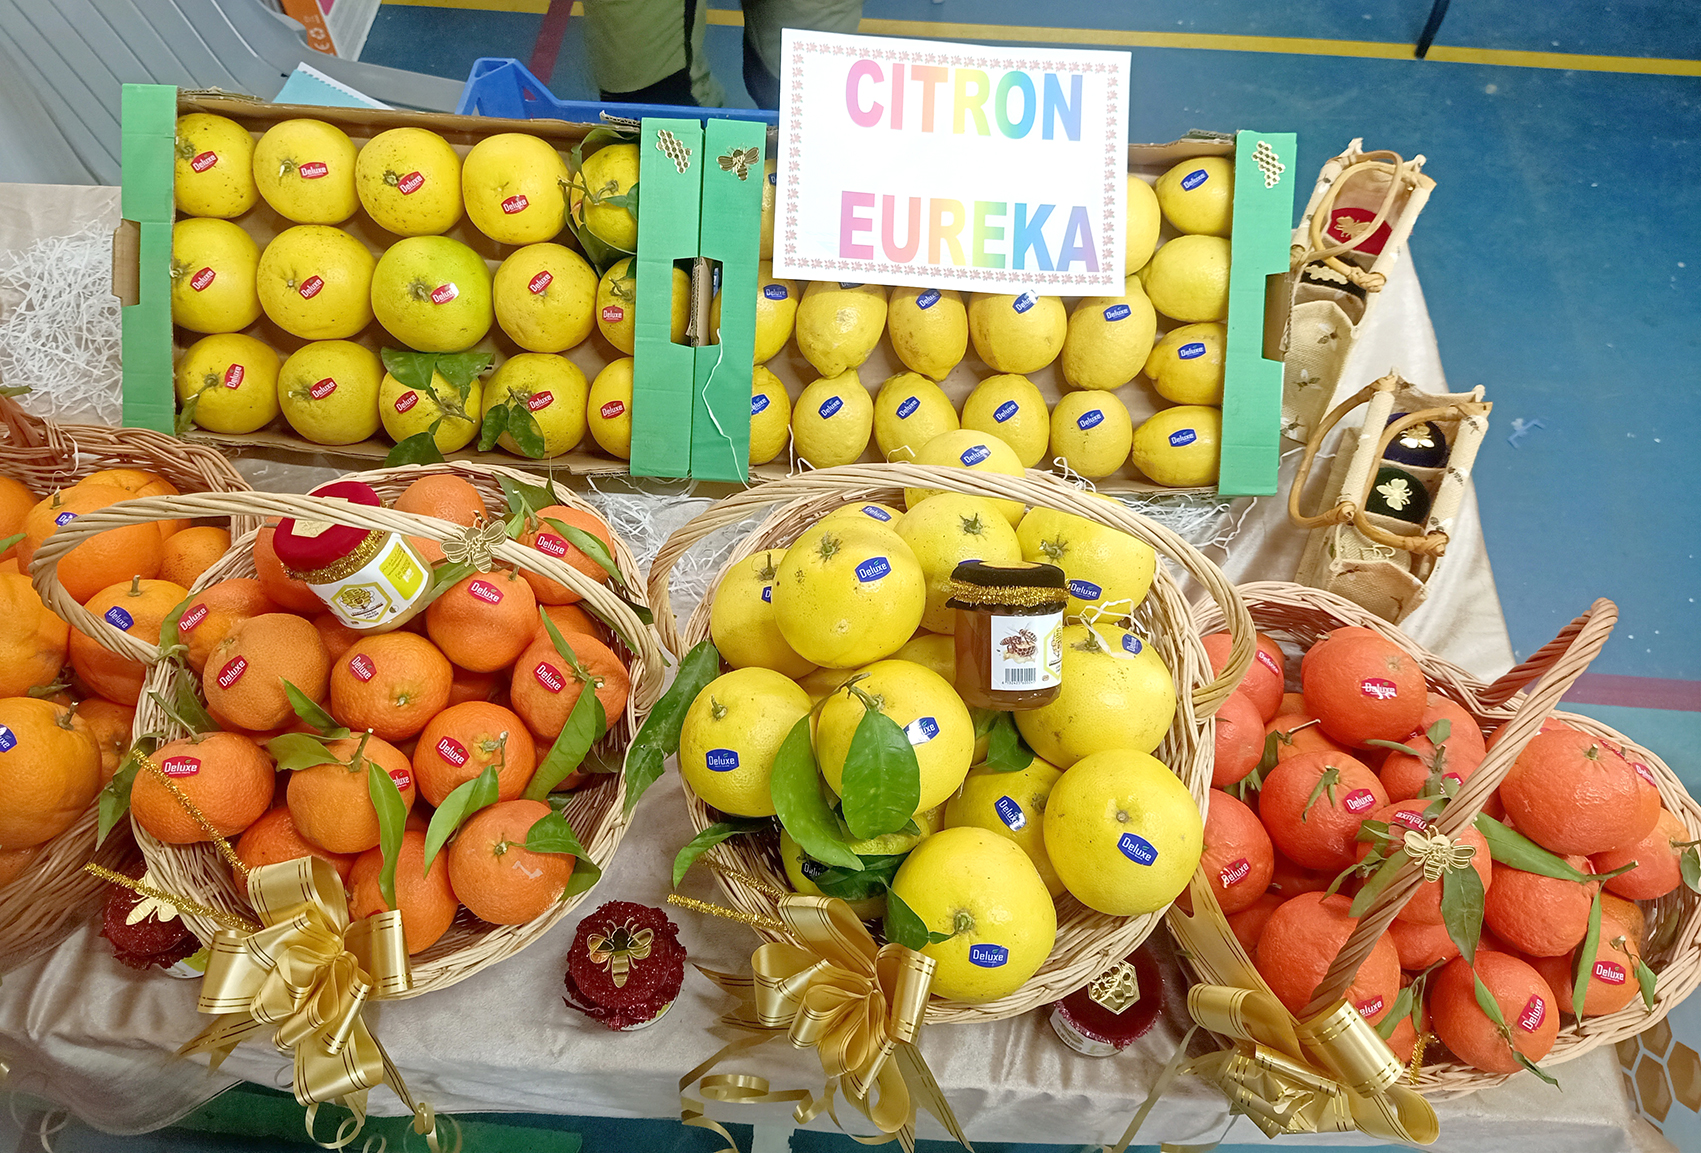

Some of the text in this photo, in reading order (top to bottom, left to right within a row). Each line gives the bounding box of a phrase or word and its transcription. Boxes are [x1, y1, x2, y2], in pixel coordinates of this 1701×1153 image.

[846, 59, 1083, 141] CITRON
[192, 155, 216, 171] Deluxe
[301, 166, 326, 176] Deluxe
[400, 175, 423, 193] Deluxe
[1183, 173, 1205, 188] Deluxe
[503, 198, 527, 212] Deluxe
[839, 190, 1100, 272] EUREKA
[192, 270, 214, 290] Deluxe
[530, 274, 552, 292] Deluxe
[300, 279, 322, 298] Deluxe
[432, 289, 455, 303] Delux
[765, 289, 786, 297] Deluxe
[919, 291, 939, 307] Deluxe
[603, 310, 622, 318] Deluxe
[1106, 308, 1128, 319] Deluxe
[1180, 346, 1203, 356] Deluxe
[226, 366, 242, 387] Deluxe
[311, 381, 335, 398] Deluxe
[396, 394, 417, 411] Deluxe
[529, 394, 552, 409] Deluxe
[750, 398, 767, 410] eluxe
[820, 400, 840, 416] Deluxe
[898, 400, 917, 417] Deluxe
[602, 404, 623, 416] Deluxe
[996, 404, 1016, 419] Deluxe
[1079, 413, 1102, 428] Deluxe
[1171, 433, 1194, 444] Deluxe
[538, 536, 565, 555] Deluxe
[859, 563, 887, 578] Deluxe
[470, 582, 499, 602] Deluxe
[1070, 583, 1097, 597] Deluxe
[108, 609, 128, 628] Deluxe
[179, 608, 206, 630] Deluxe
[219, 660, 245, 686] Deluxe
[351, 656, 371, 680] Deluxe
[536, 664, 561, 690] Deluxe
[438, 739, 464, 764] Deluxe
[164, 762, 197, 773] Deluxe
[708, 756, 735, 765] Deluxe
[393, 776, 409, 786] eluxe
[1346, 794, 1374, 810] Deluxe
[999, 800, 1018, 822] Delux
[1395, 811, 1427, 830] Deluxe
[1121, 836, 1151, 861] Deluxe
[972, 949, 1004, 961] Deluxe
[1596, 964, 1624, 980] Deluxe
[1360, 1001, 1382, 1017] eluxe
[1522, 998, 1543, 1029] Deluxe
